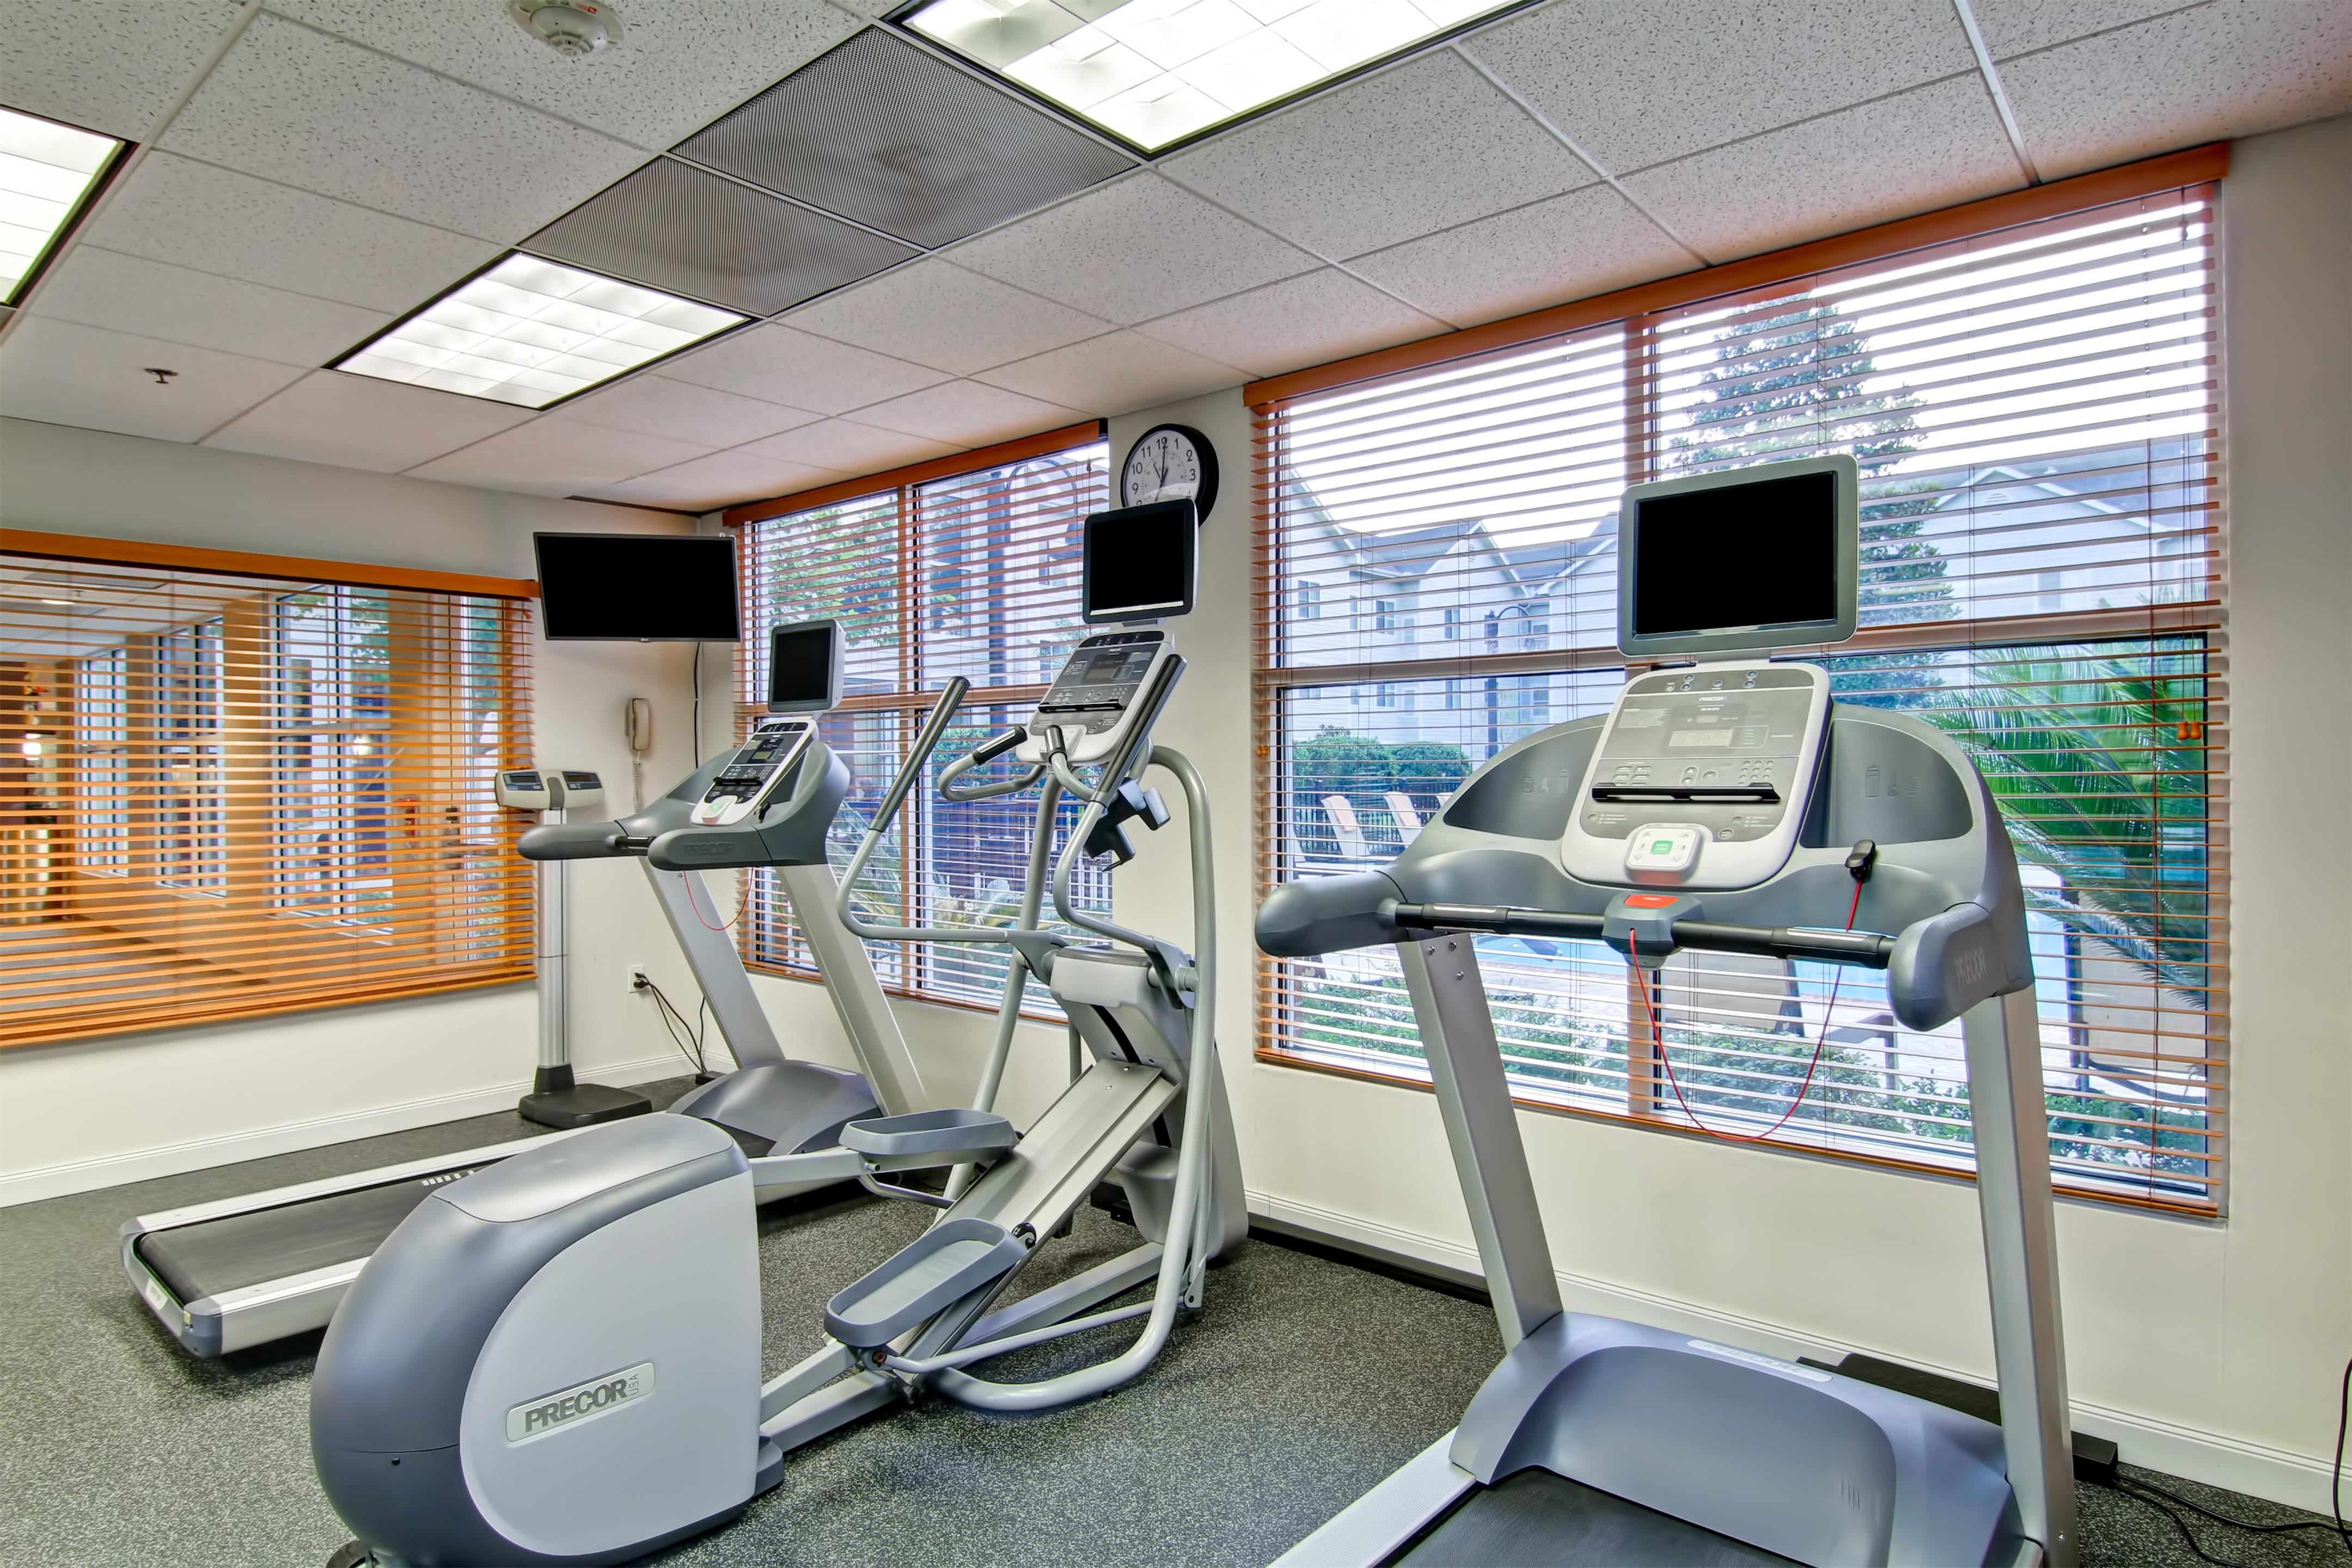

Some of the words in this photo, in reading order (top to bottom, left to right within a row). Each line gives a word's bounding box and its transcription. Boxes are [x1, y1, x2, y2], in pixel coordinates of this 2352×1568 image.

[1156, 437, 1168, 450] 12
[1174, 438, 1179, 450] 1
[1141, 445, 1151, 458] 11
[1186, 449, 1193, 462] 2
[1132, 462, 1143, 475] 10
[1189, 468, 1196, 481] 3
[1132, 482, 1139, 494] 9
[526, 1378, 627, 1432] PRECOR
[628, 1373, 639, 1396] USA
